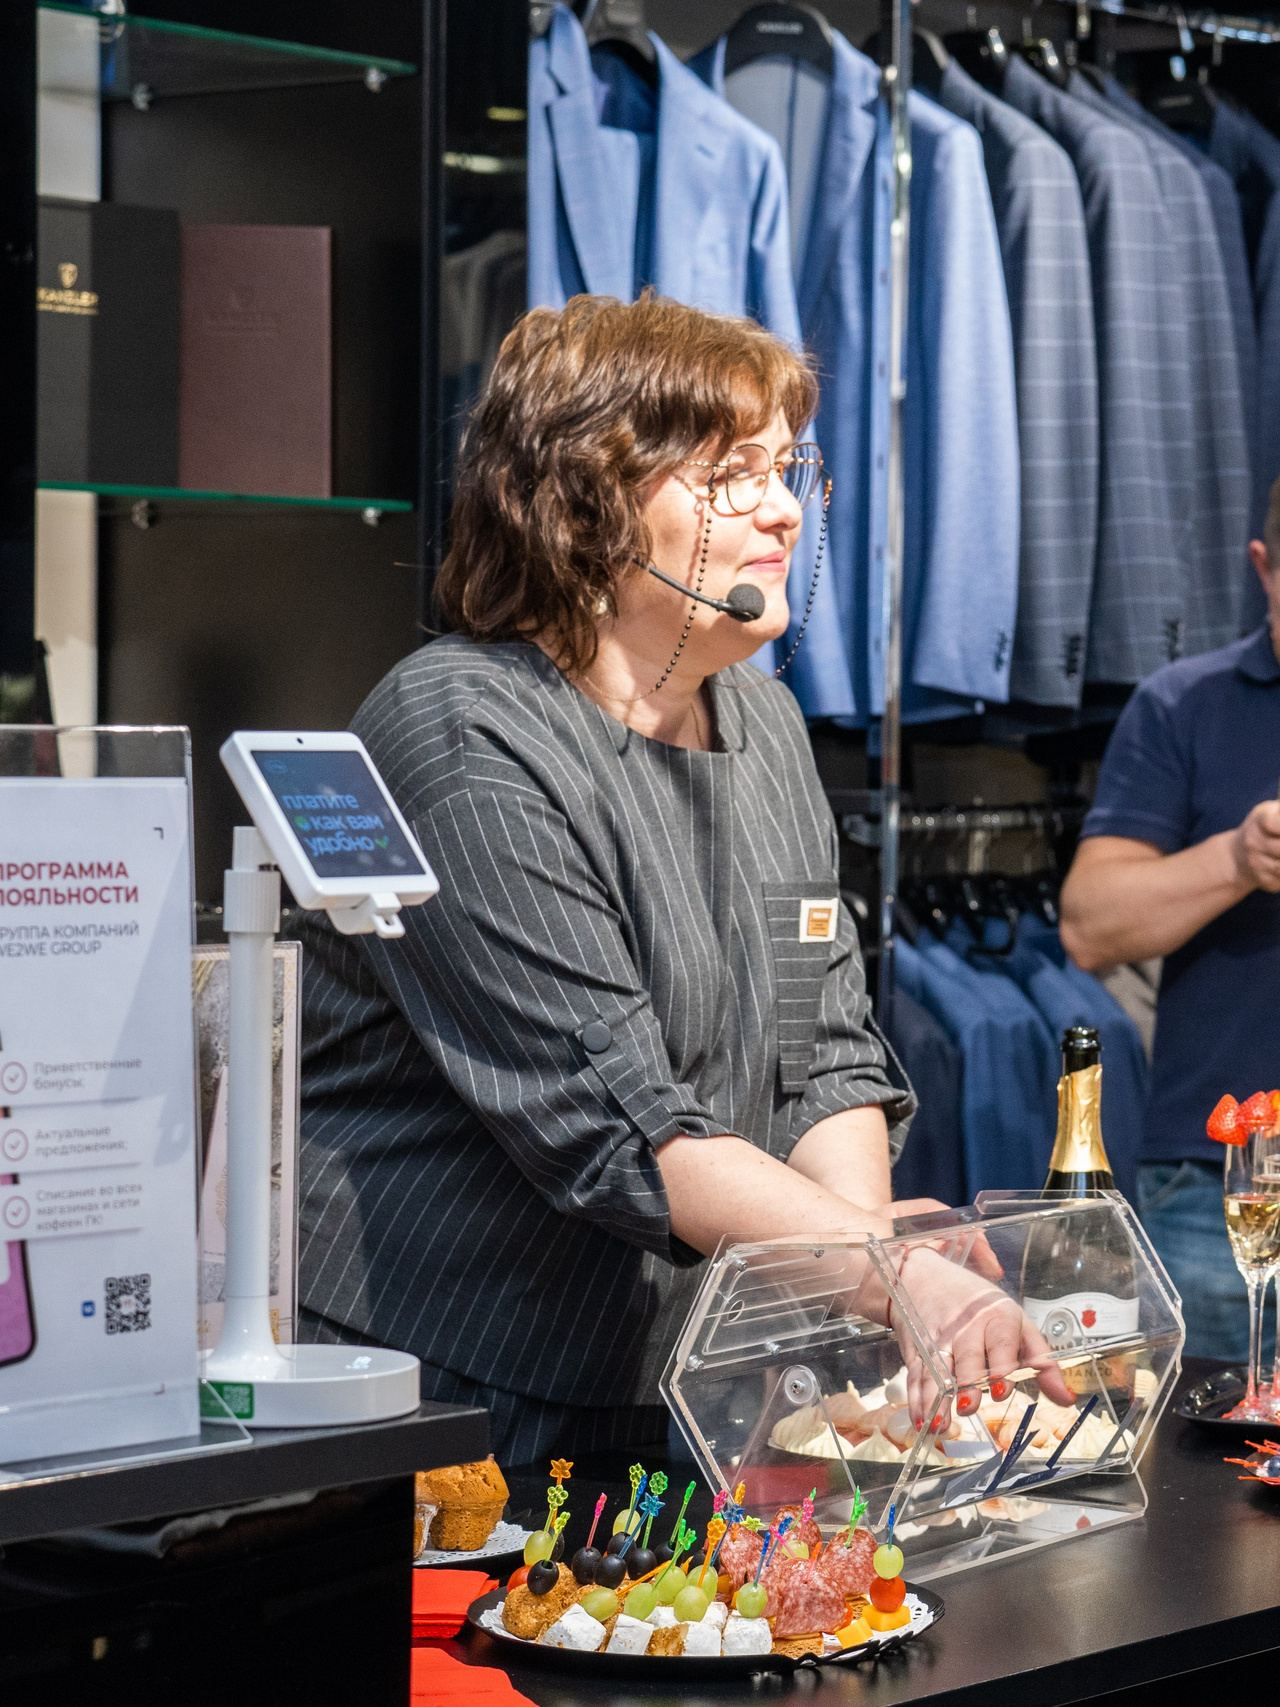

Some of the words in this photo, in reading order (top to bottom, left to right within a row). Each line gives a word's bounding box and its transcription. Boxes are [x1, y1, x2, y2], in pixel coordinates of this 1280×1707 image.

[281, 793, 360, 810] платите
[309, 814, 348, 831] как
[346, 814, 385, 831] вам
[304, 831, 376, 857] удобно
[0, 861, 130, 881] РОГРАММА
[53, 919, 140, 939] КОМПАНИЙ
[51, 939, 103, 956] GROUP
